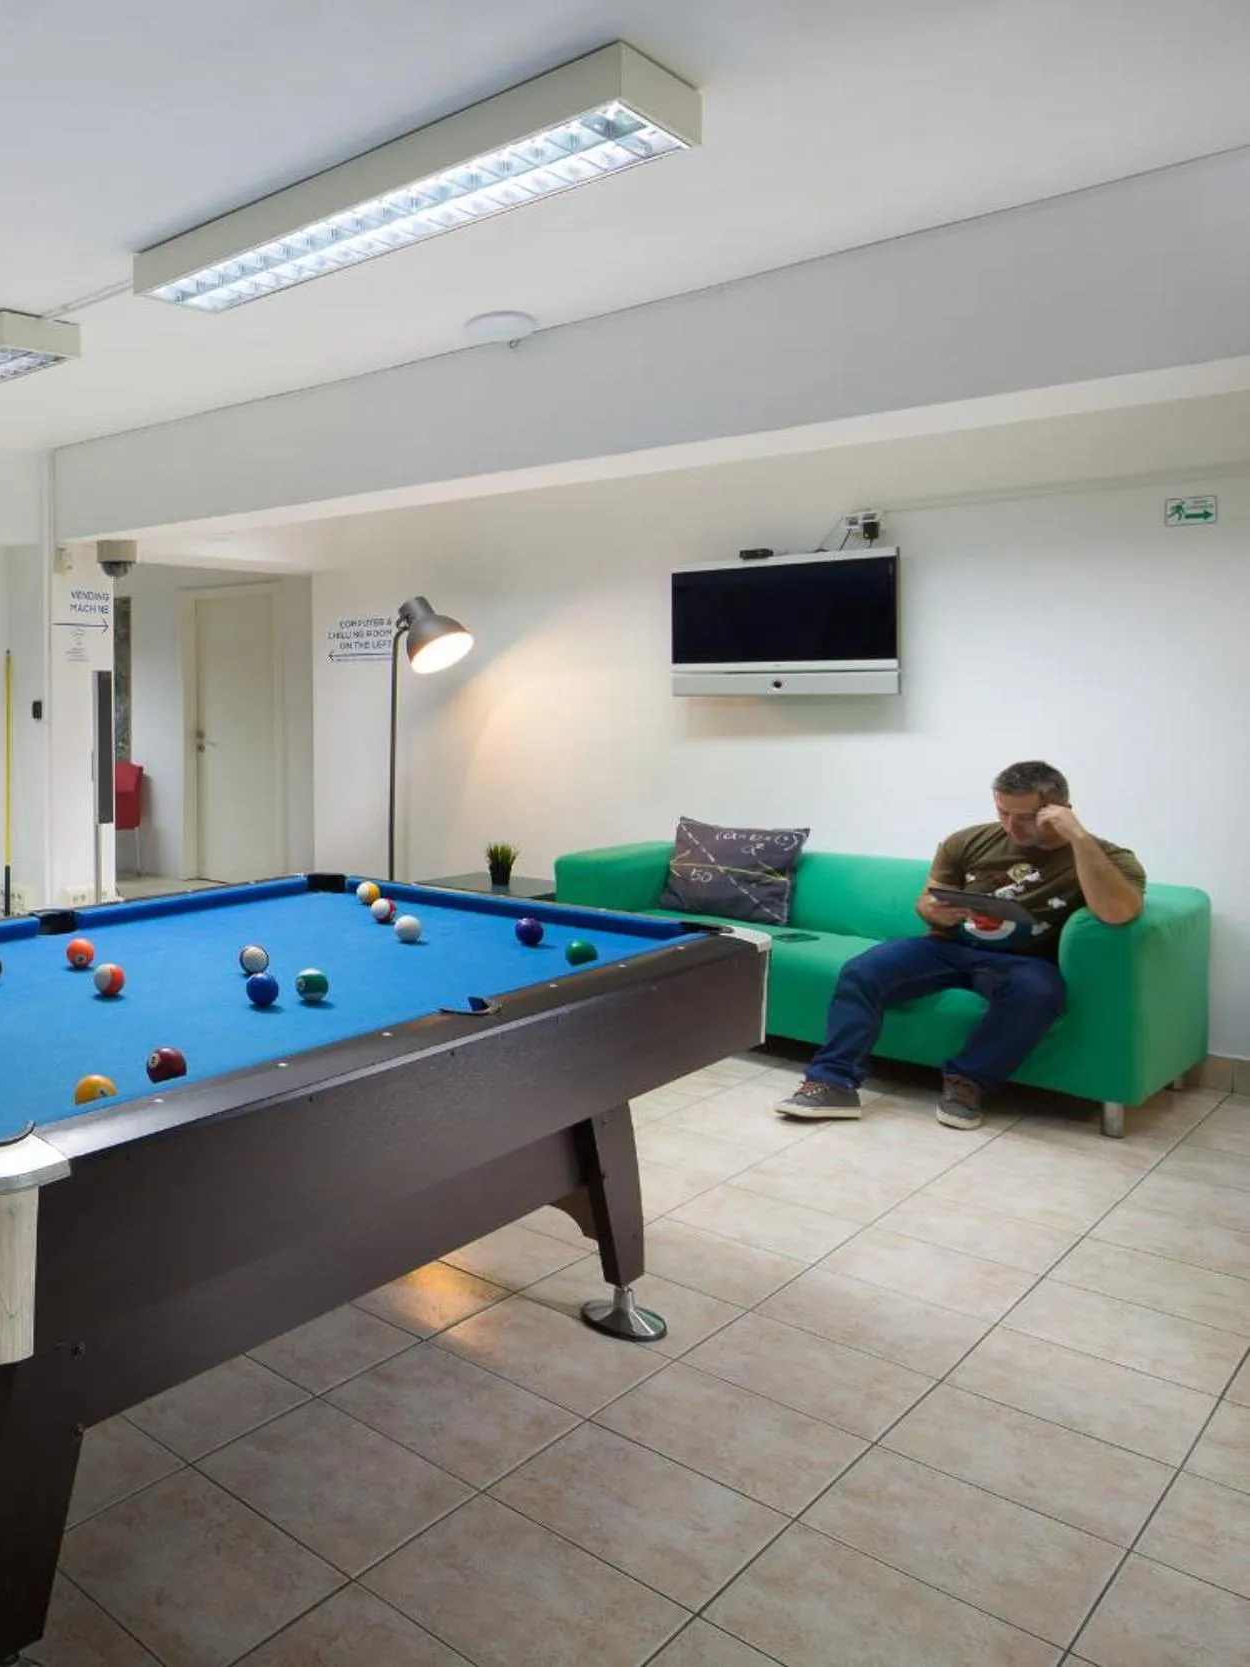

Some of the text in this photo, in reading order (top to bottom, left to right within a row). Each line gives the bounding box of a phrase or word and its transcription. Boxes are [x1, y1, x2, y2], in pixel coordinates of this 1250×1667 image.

[70, 590, 111, 602] VENDING
[69, 603, 110, 614] MACHINE
[338, 617, 385, 629] COMPUTER
[365, 629, 393, 638] ROOM
[339, 639, 393, 651] ON THE LEFT
